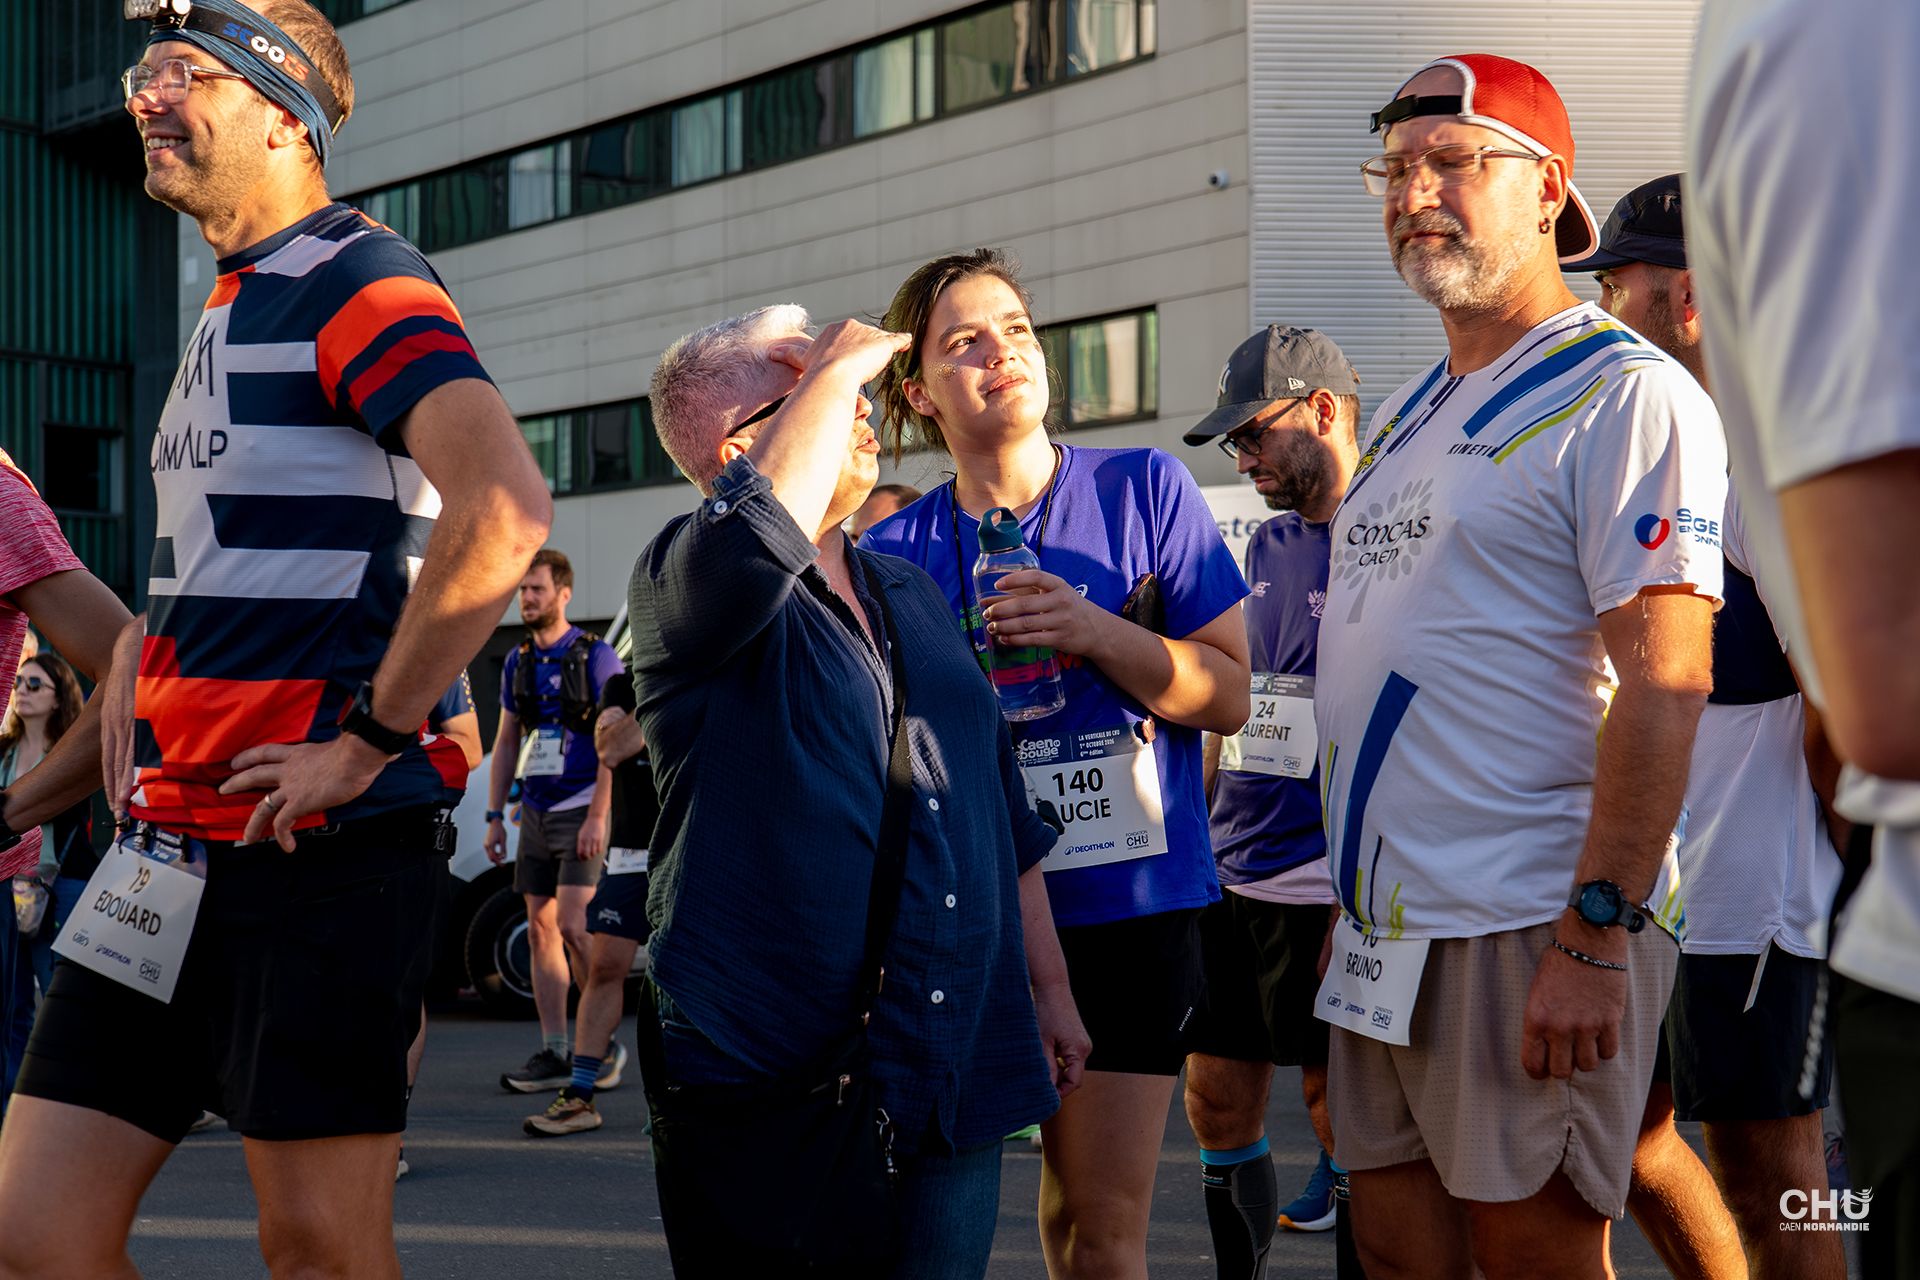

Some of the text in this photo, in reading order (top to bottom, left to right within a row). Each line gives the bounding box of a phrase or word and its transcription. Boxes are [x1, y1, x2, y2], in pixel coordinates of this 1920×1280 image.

[1255, 701, 1276, 719] 24
[1241, 723, 1292, 741] AURENT
[1283, 758, 1300, 768] CHU
[1051, 767, 1104, 796] 140
[1060, 798, 1112, 823] UCIE
[1074, 841, 1115, 853] DECATHLON
[1126, 834, 1149, 847] CHU
[92, 889, 162, 936] EDOUARD
[139, 962, 162, 980] CHU
[1346, 952, 1383, 982] BRUNO
[1372, 1011, 1392, 1026] CHU
